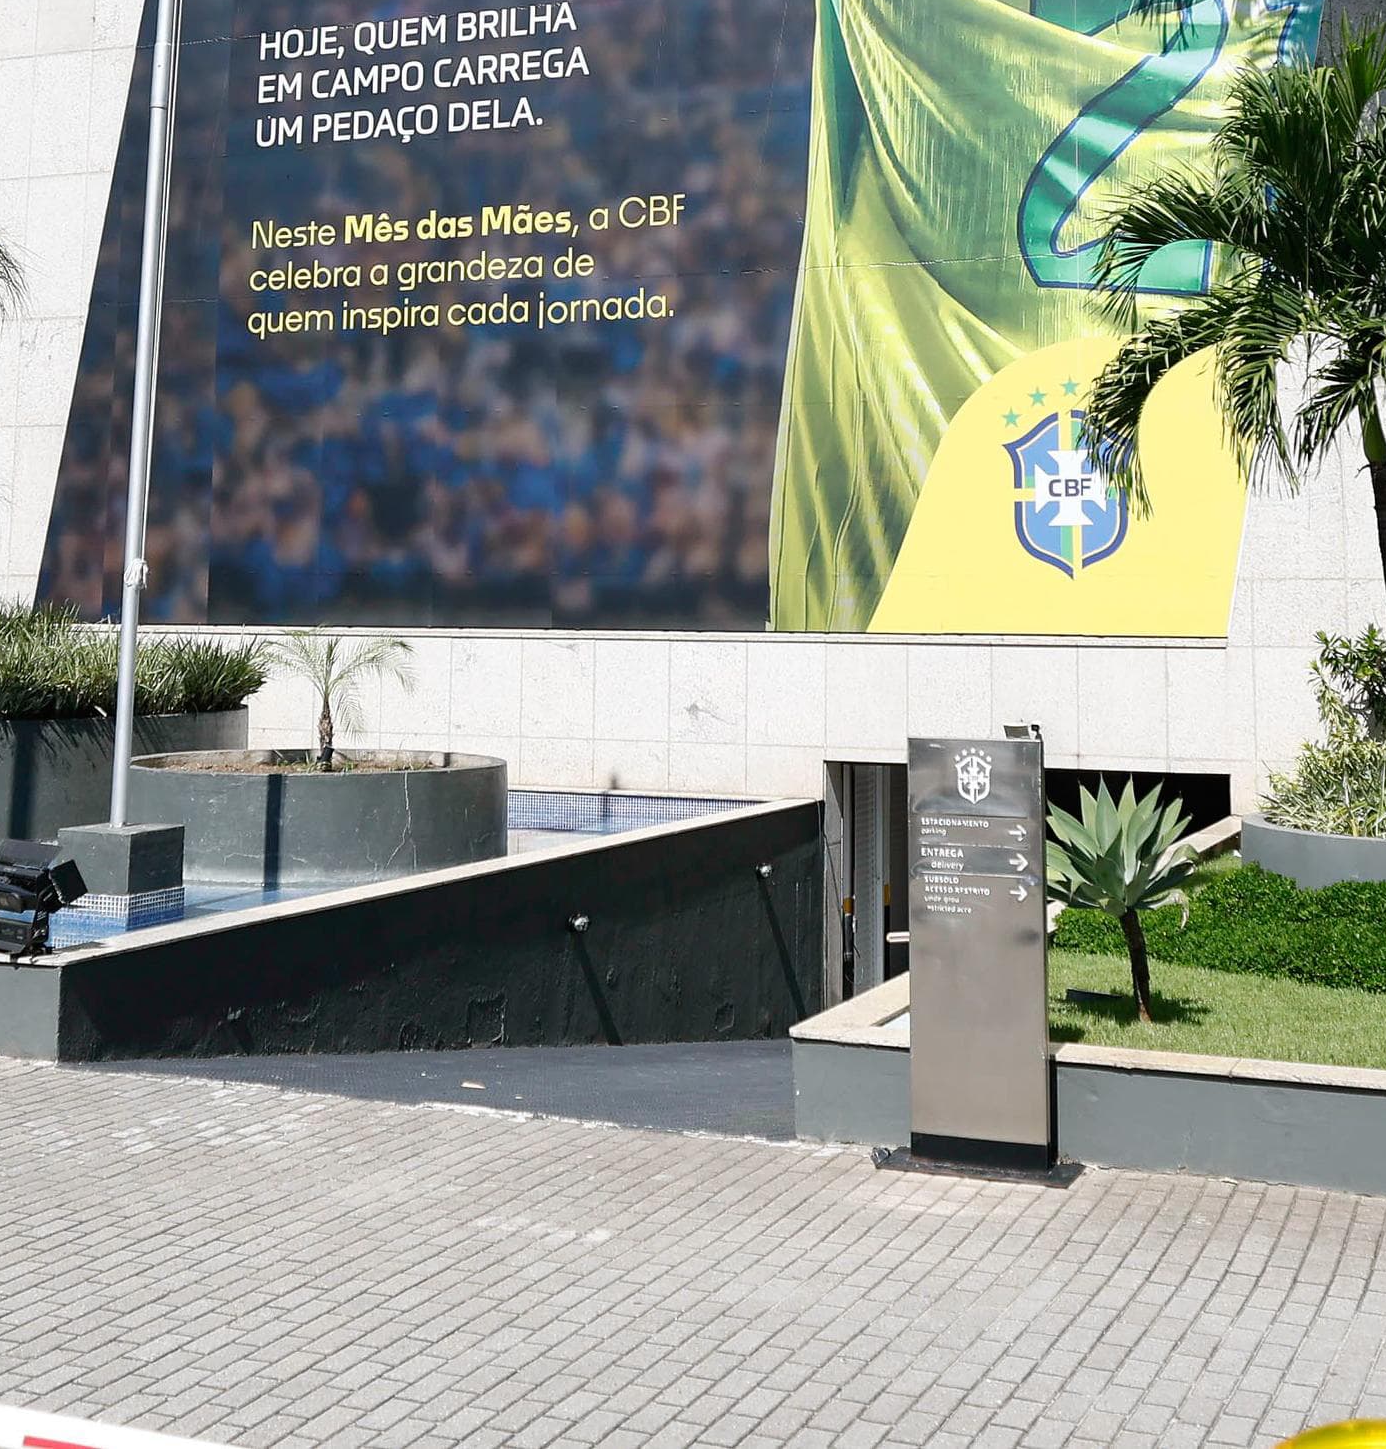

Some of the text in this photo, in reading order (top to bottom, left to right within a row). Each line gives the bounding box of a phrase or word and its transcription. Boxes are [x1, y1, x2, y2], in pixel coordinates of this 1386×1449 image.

[259, 1, 577, 61] HOJE, QUEM BRILHA
[257, 45, 590, 104] EM CAMPO CARREGA
[256, 96, 544, 148] UM PEDAÇO DELA.
[251, 193, 687, 250] Neste Mês das Mães, a CBF
[249, 247, 595, 293] celebra a grandeza de
[247, 287, 675, 341] quem inspira cada jornada.
[1048, 477, 1092, 497] CBF
[920, 817, 990, 828] ESTACIONAMENTO
[920, 847, 964, 858] ENTREGA
[931, 861, 964, 871] delivery
